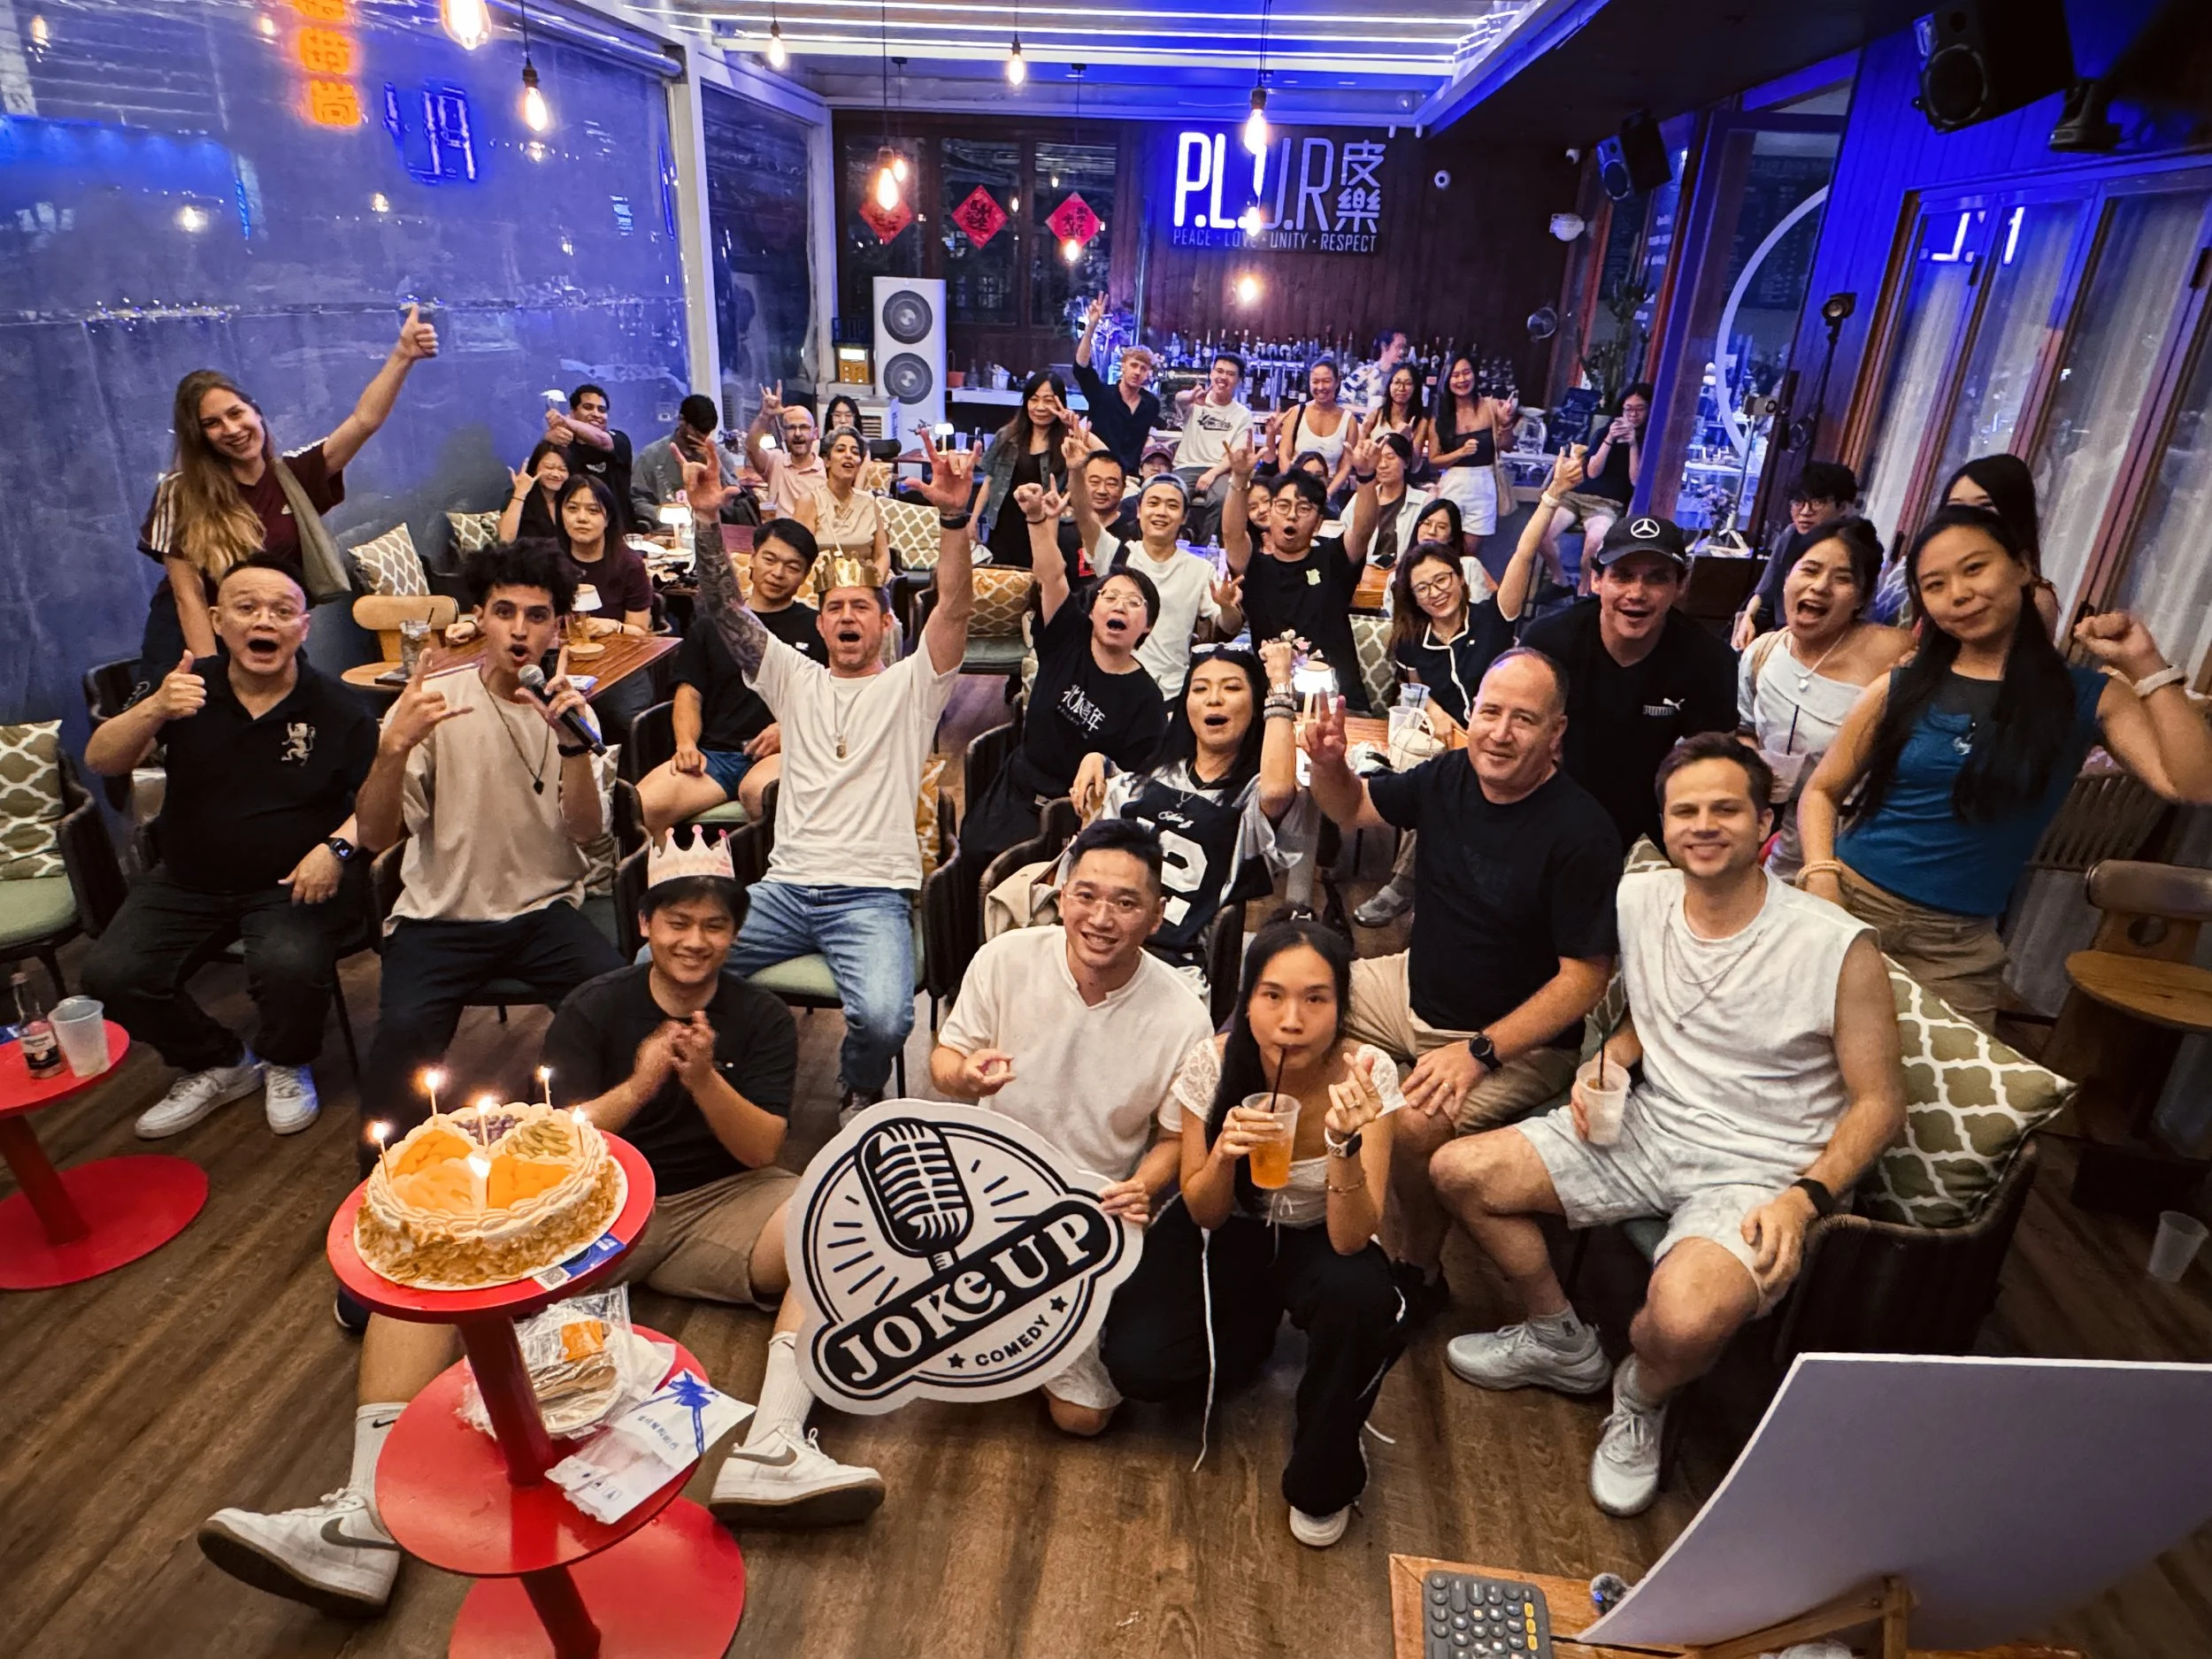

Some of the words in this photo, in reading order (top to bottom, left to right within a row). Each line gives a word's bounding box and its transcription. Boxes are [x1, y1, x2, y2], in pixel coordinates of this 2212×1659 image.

[1334, 139, 1387, 234] 皮樂
[1172, 227, 1211, 246] PEACE
[1270, 231, 1308, 250] UNITY
[1319, 233, 1377, 252] RESPECT
[975, 1314, 1050, 1367] COMEDY
